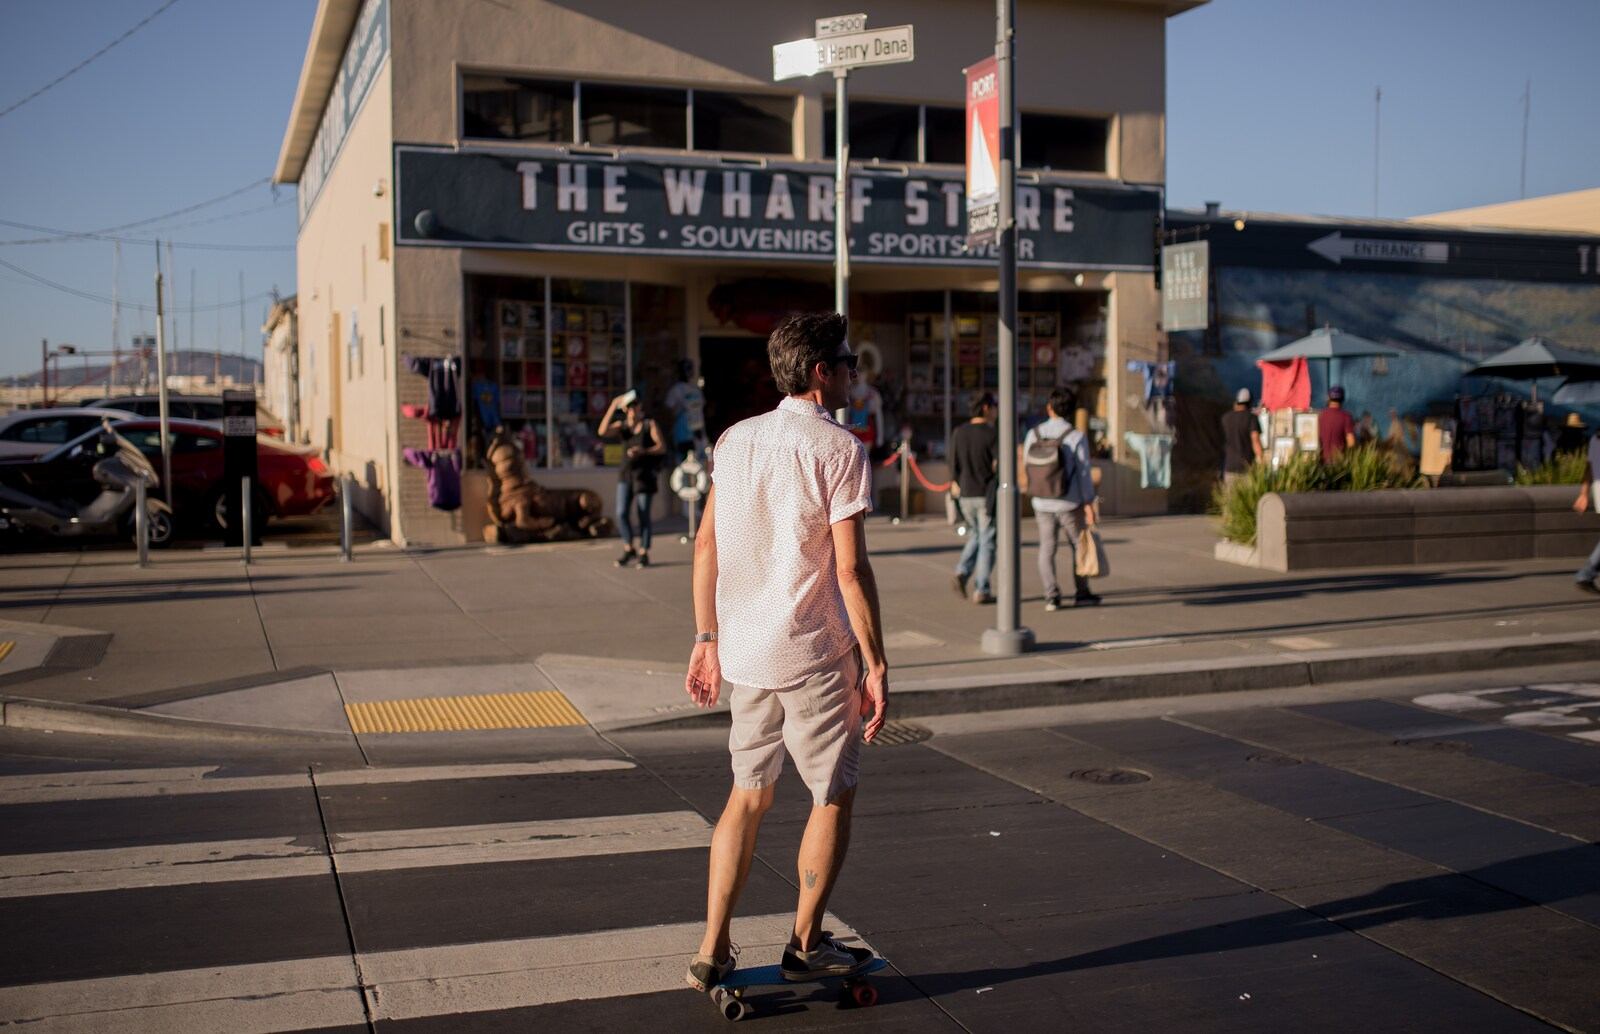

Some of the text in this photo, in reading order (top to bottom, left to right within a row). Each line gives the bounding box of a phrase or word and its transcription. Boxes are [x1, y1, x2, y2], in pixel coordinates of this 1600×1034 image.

[830, 42, 869, 61] Henry
[874, 38, 908, 56] Dana
[972, 73, 996, 98] PORT
[516, 161, 1075, 233] THE WHARF STRE
[566, 221, 645, 244] GIFTS
[680, 225, 834, 251] SOUVENIRS
[1353, 242, 1425, 260] ENTRANCE
